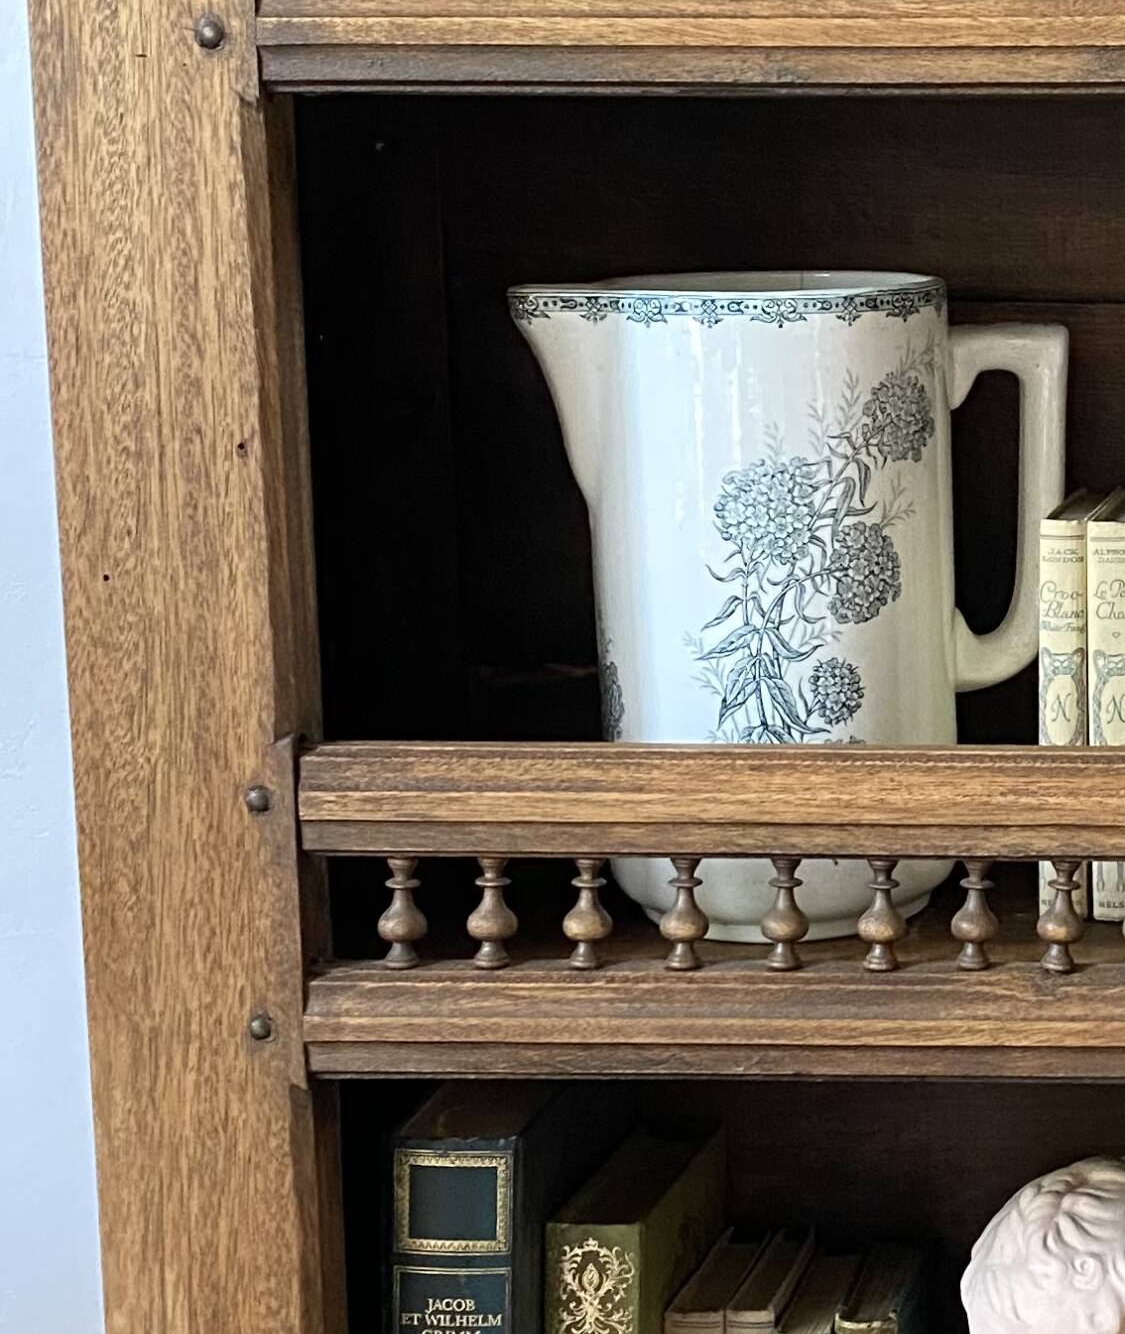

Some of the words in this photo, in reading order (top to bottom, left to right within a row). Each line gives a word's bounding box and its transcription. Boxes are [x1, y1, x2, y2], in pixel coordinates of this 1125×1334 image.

[1042, 555, 1085, 564] LONDON
[1047, 548, 1079, 556] JACK
[1039, 579, 1085, 604] Croc-
[1093, 580, 1109, 601] Le
[1042, 600, 1085, 620] Blanc
[1051, 693, 1072, 723] N
[425, 1298, 477, 1314] JACOB
[401, 1313, 422, 1326] ET
[424, 1313, 503, 1328] WILHELM
